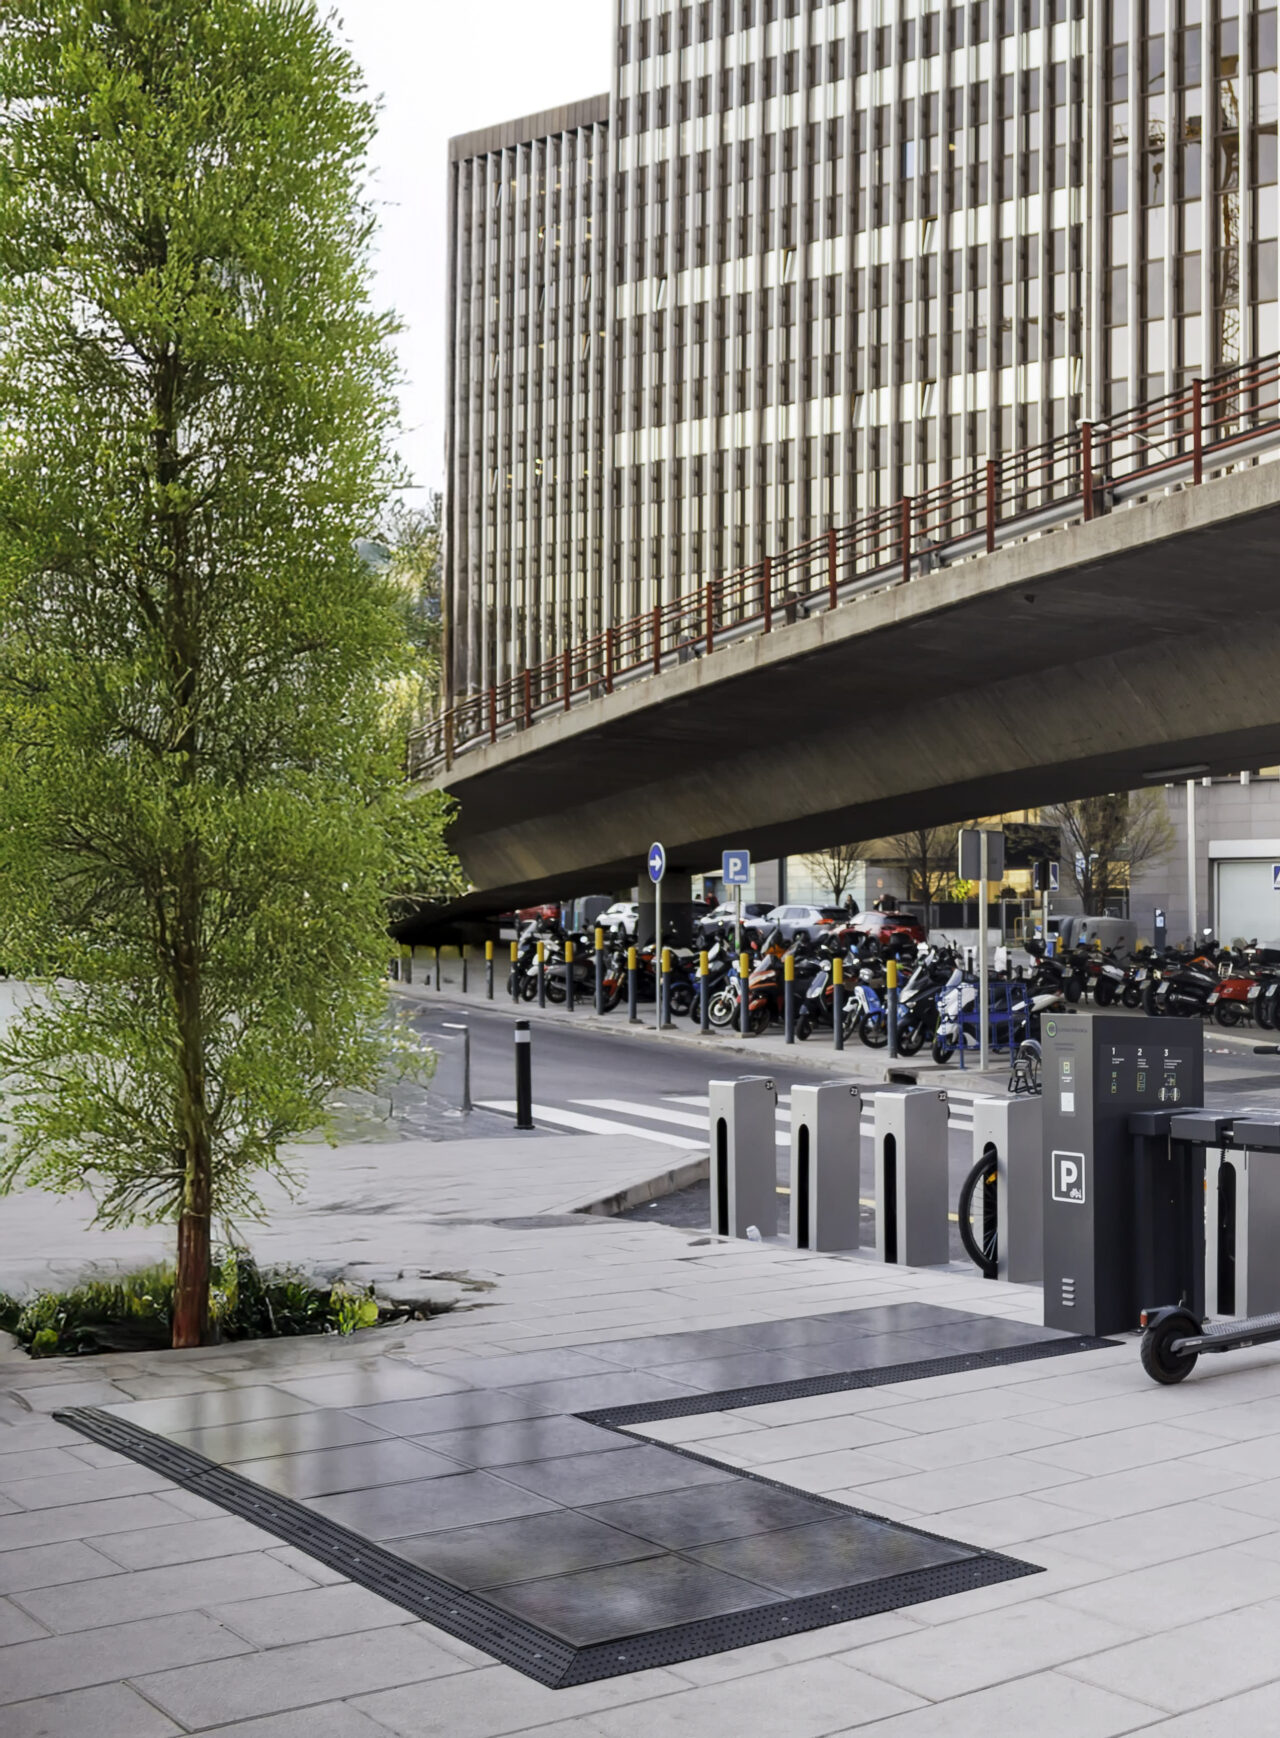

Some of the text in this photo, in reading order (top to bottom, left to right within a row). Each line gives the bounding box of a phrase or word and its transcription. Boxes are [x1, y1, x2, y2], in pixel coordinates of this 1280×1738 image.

[729, 857, 742, 880] P
[1111, 1047, 1116, 1056] 1
[1137, 1048, 1143, 1056] 2
[1163, 1048, 1169, 1057] 3
[1060, 1160, 1078, 1192] P
